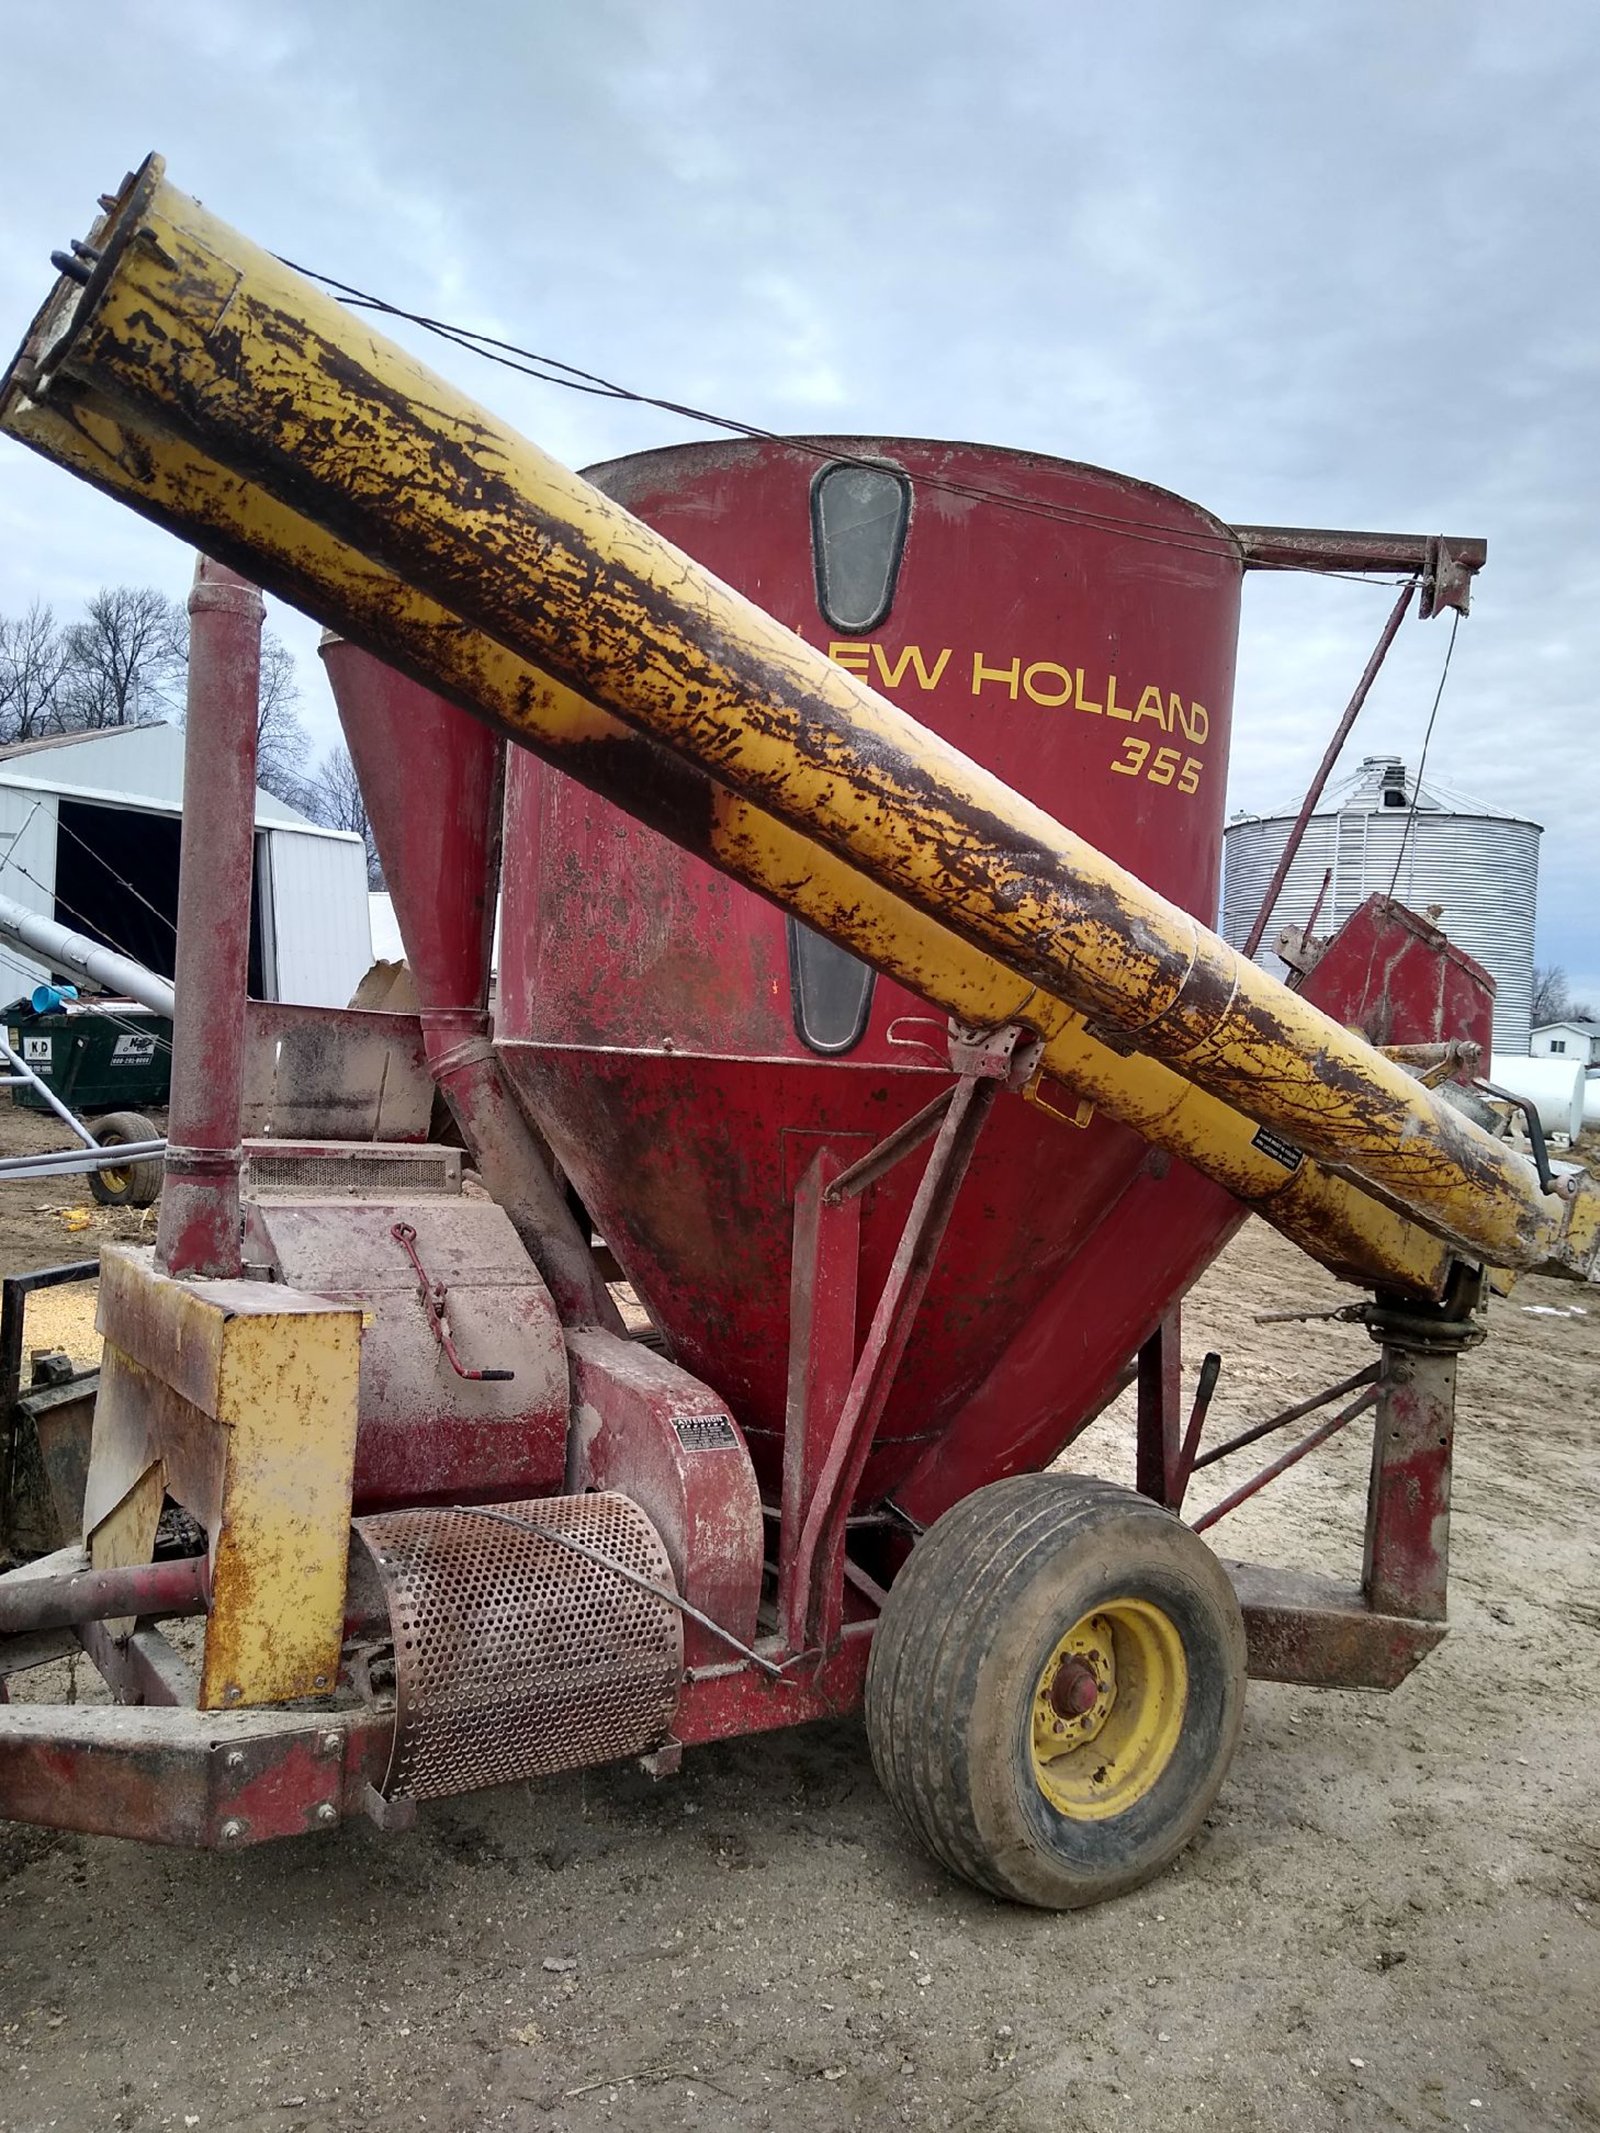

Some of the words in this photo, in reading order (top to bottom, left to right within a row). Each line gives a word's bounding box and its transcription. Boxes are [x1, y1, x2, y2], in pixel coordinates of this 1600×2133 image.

[828, 641, 952, 691] EW
[971, 652, 1210, 745] HOLLAND
[1110, 736, 1204, 795] 355
